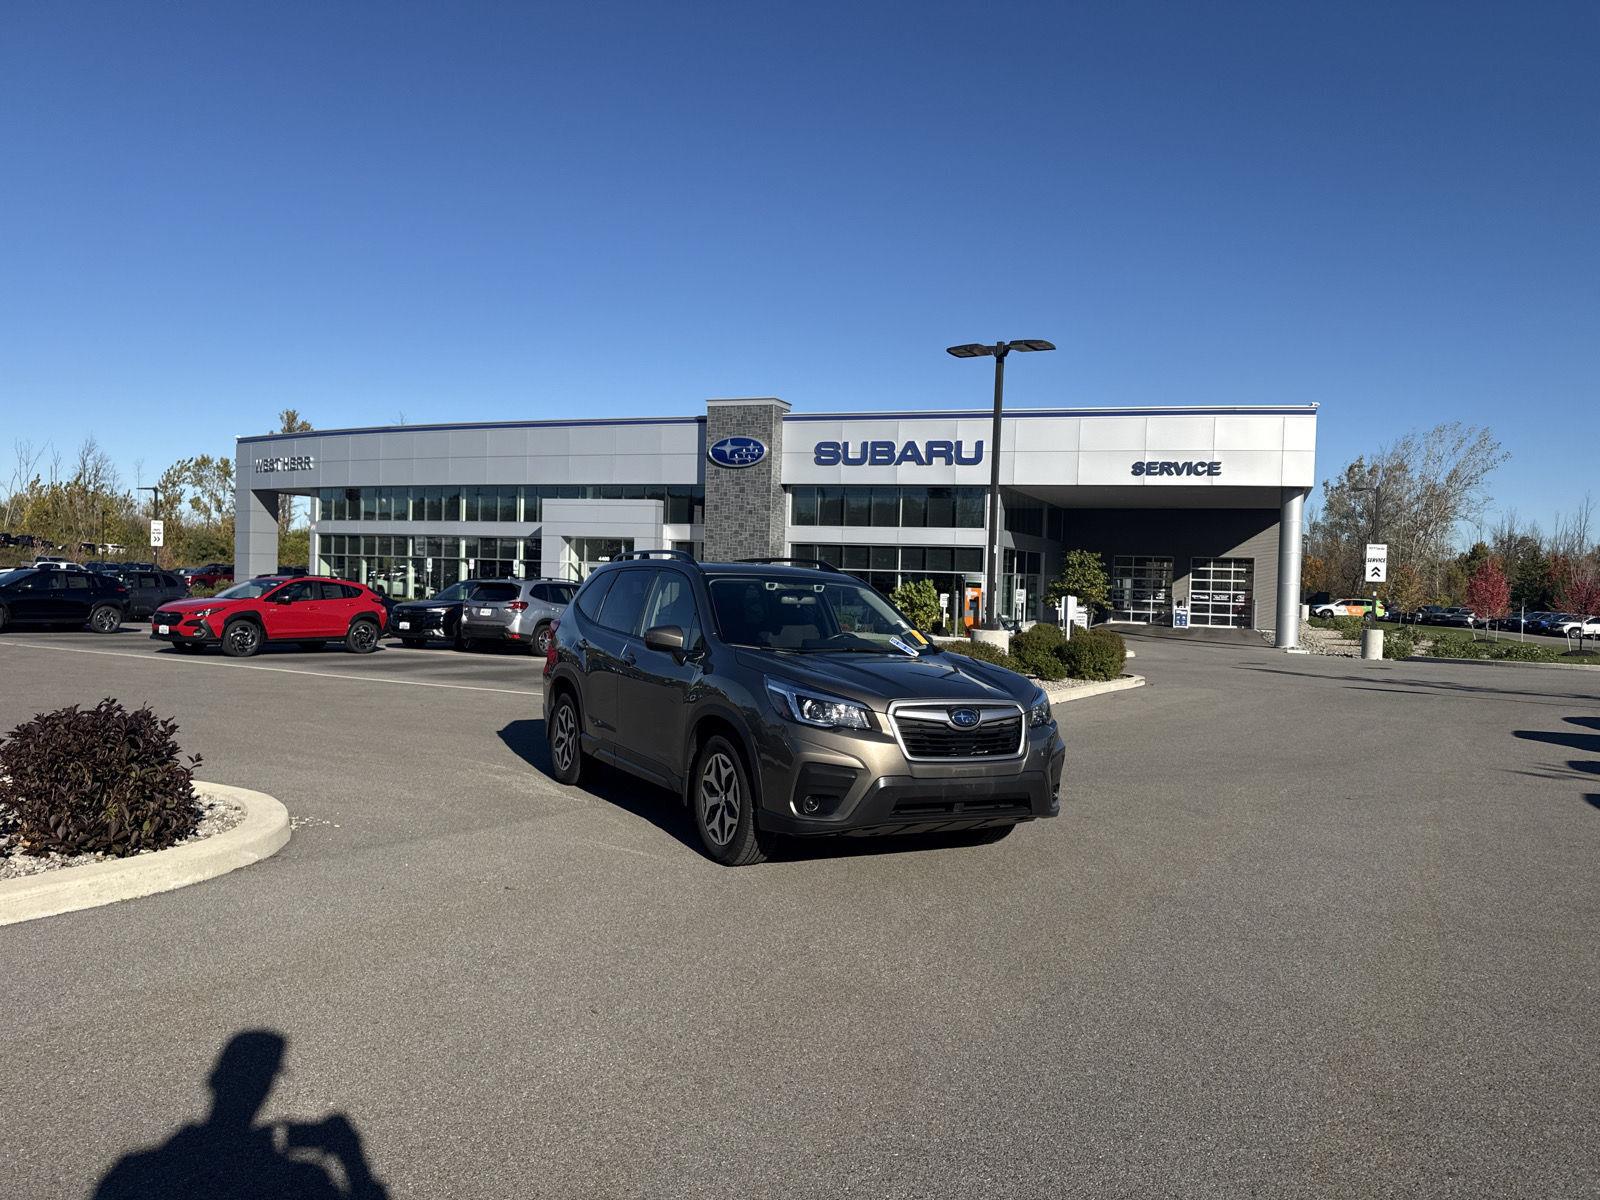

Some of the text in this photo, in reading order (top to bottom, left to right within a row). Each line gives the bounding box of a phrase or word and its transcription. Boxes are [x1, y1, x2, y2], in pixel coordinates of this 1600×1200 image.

[814, 440, 984, 466] SUBARU
[255, 456, 314, 473] WEST HERR
[1131, 461, 1222, 476] SERVICE
